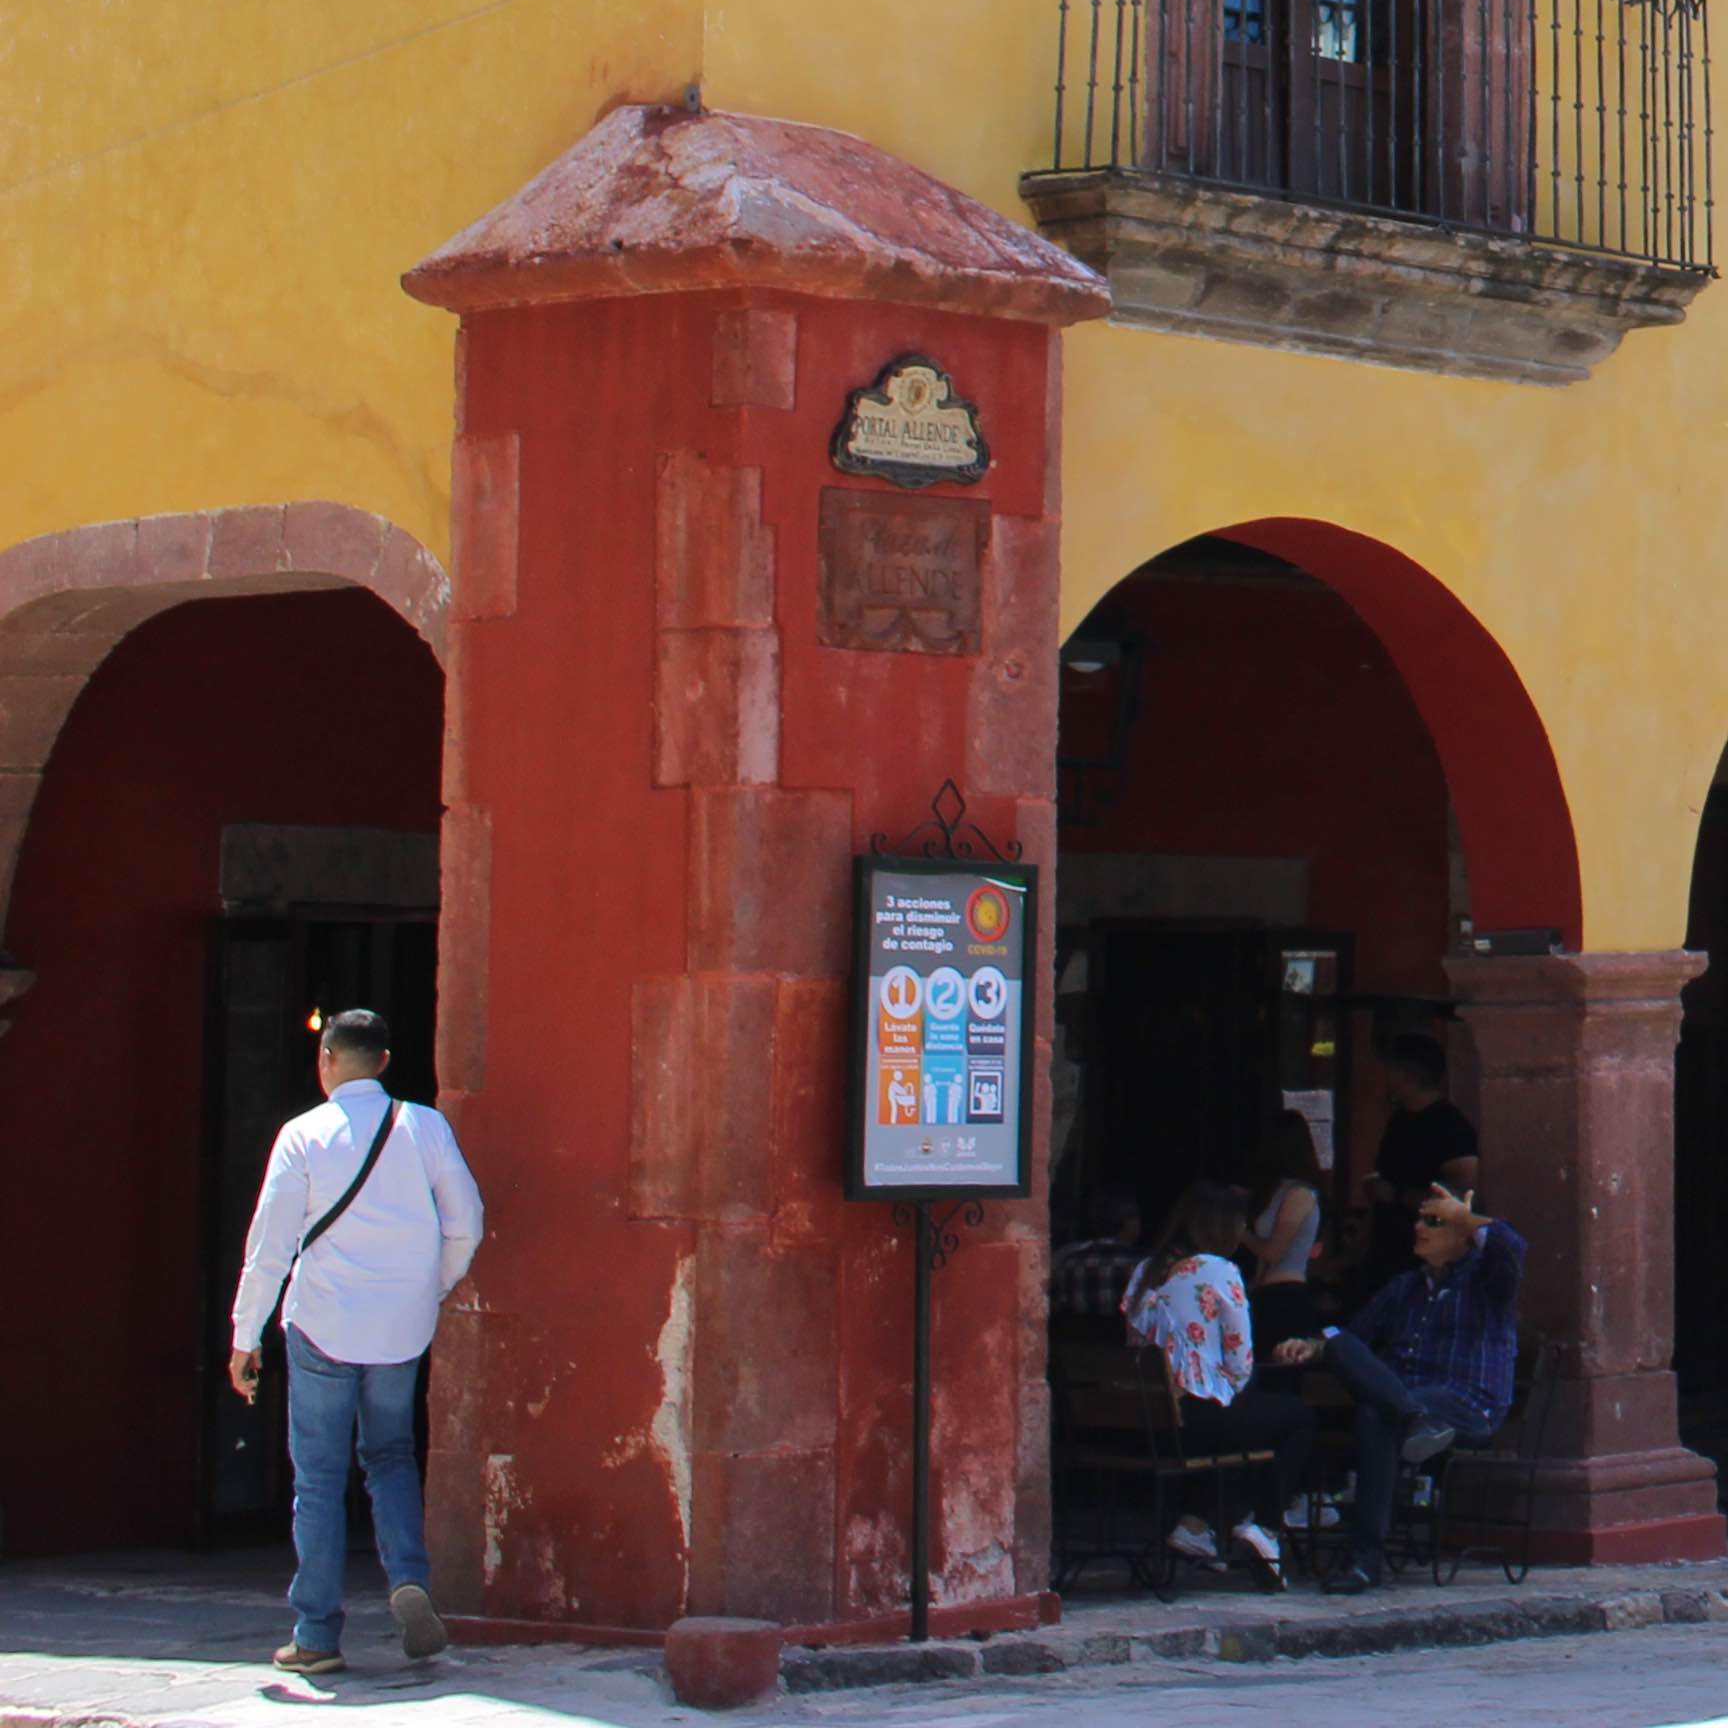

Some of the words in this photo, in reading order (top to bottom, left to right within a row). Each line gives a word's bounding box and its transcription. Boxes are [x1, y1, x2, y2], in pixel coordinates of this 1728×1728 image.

[855, 415, 897, 439] PORTAL
[903, 420, 961, 444] ALLENDE
[848, 561, 963, 601] ALLENDE
[886, 895, 895, 908] 3
[897, 897, 951, 910] acciones
[876, 911, 903, 923] para
[905, 910, 961, 924] disminuir
[892, 924, 904, 936] el
[907, 925, 945, 939] riesgo
[882, 937, 898, 950] de
[901, 939, 953, 954] contagio
